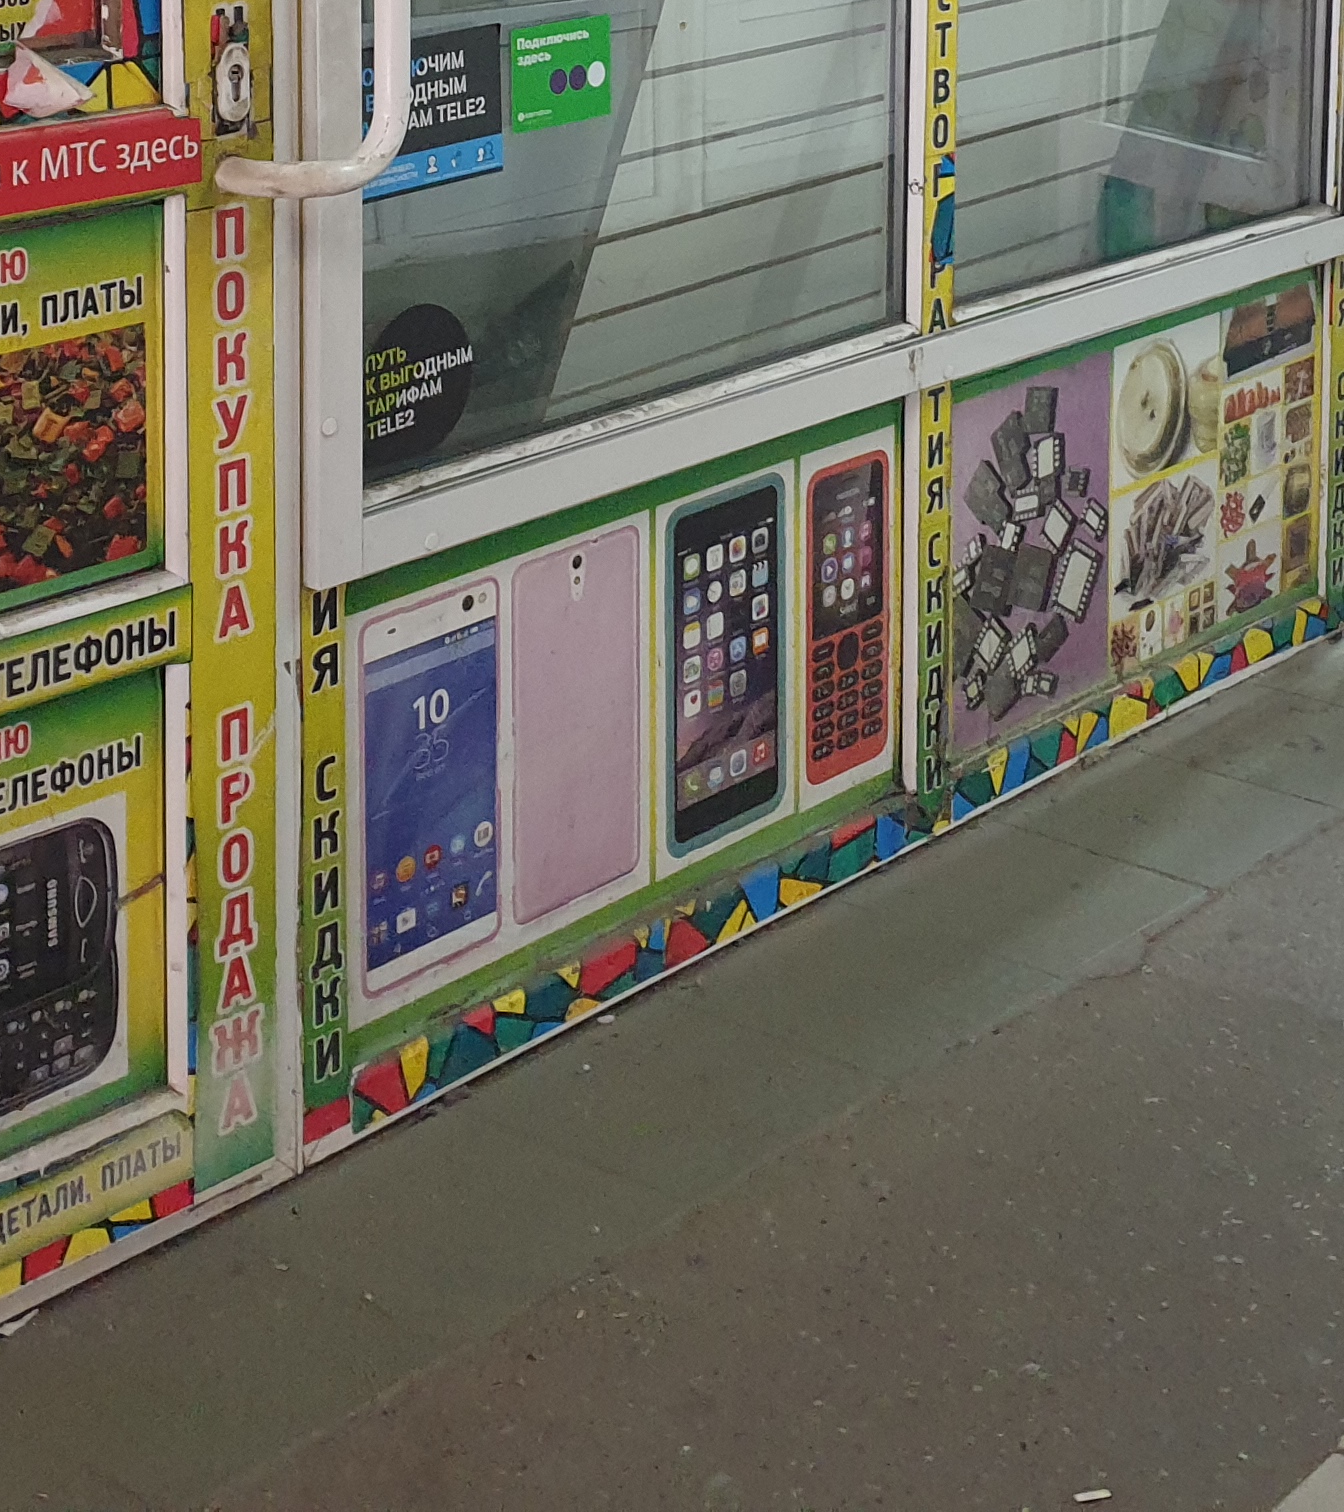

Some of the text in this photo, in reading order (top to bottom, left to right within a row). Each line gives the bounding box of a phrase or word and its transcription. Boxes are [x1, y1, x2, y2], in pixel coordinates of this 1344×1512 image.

[517, 30, 590, 50] Подключись
[517, 51, 552, 66] здесь
[437, 96, 486, 123] TELE2
[12, 162, 29, 187] к
[40, 139, 106, 181] МТС
[116, 130, 199, 174] здесь
[41, 277, 143, 327] ПЛАТЫ
[365, 345, 407, 375] ПУТЬ
[365, 343, 474, 396] К ВЫГОДНЫМ
[367, 376, 443, 419] ТАРИФАМ
[215, 208, 250, 638] ПОКУПКА
[367, 409, 415, 441] TELE2
[413, 688, 449, 729] 10
[217, 711, 258, 1129] ПРОДАЖА
[312, 755, 342, 1084] СКИДКИ
[101, 1131, 181, 1191] ПЛАТЫ
